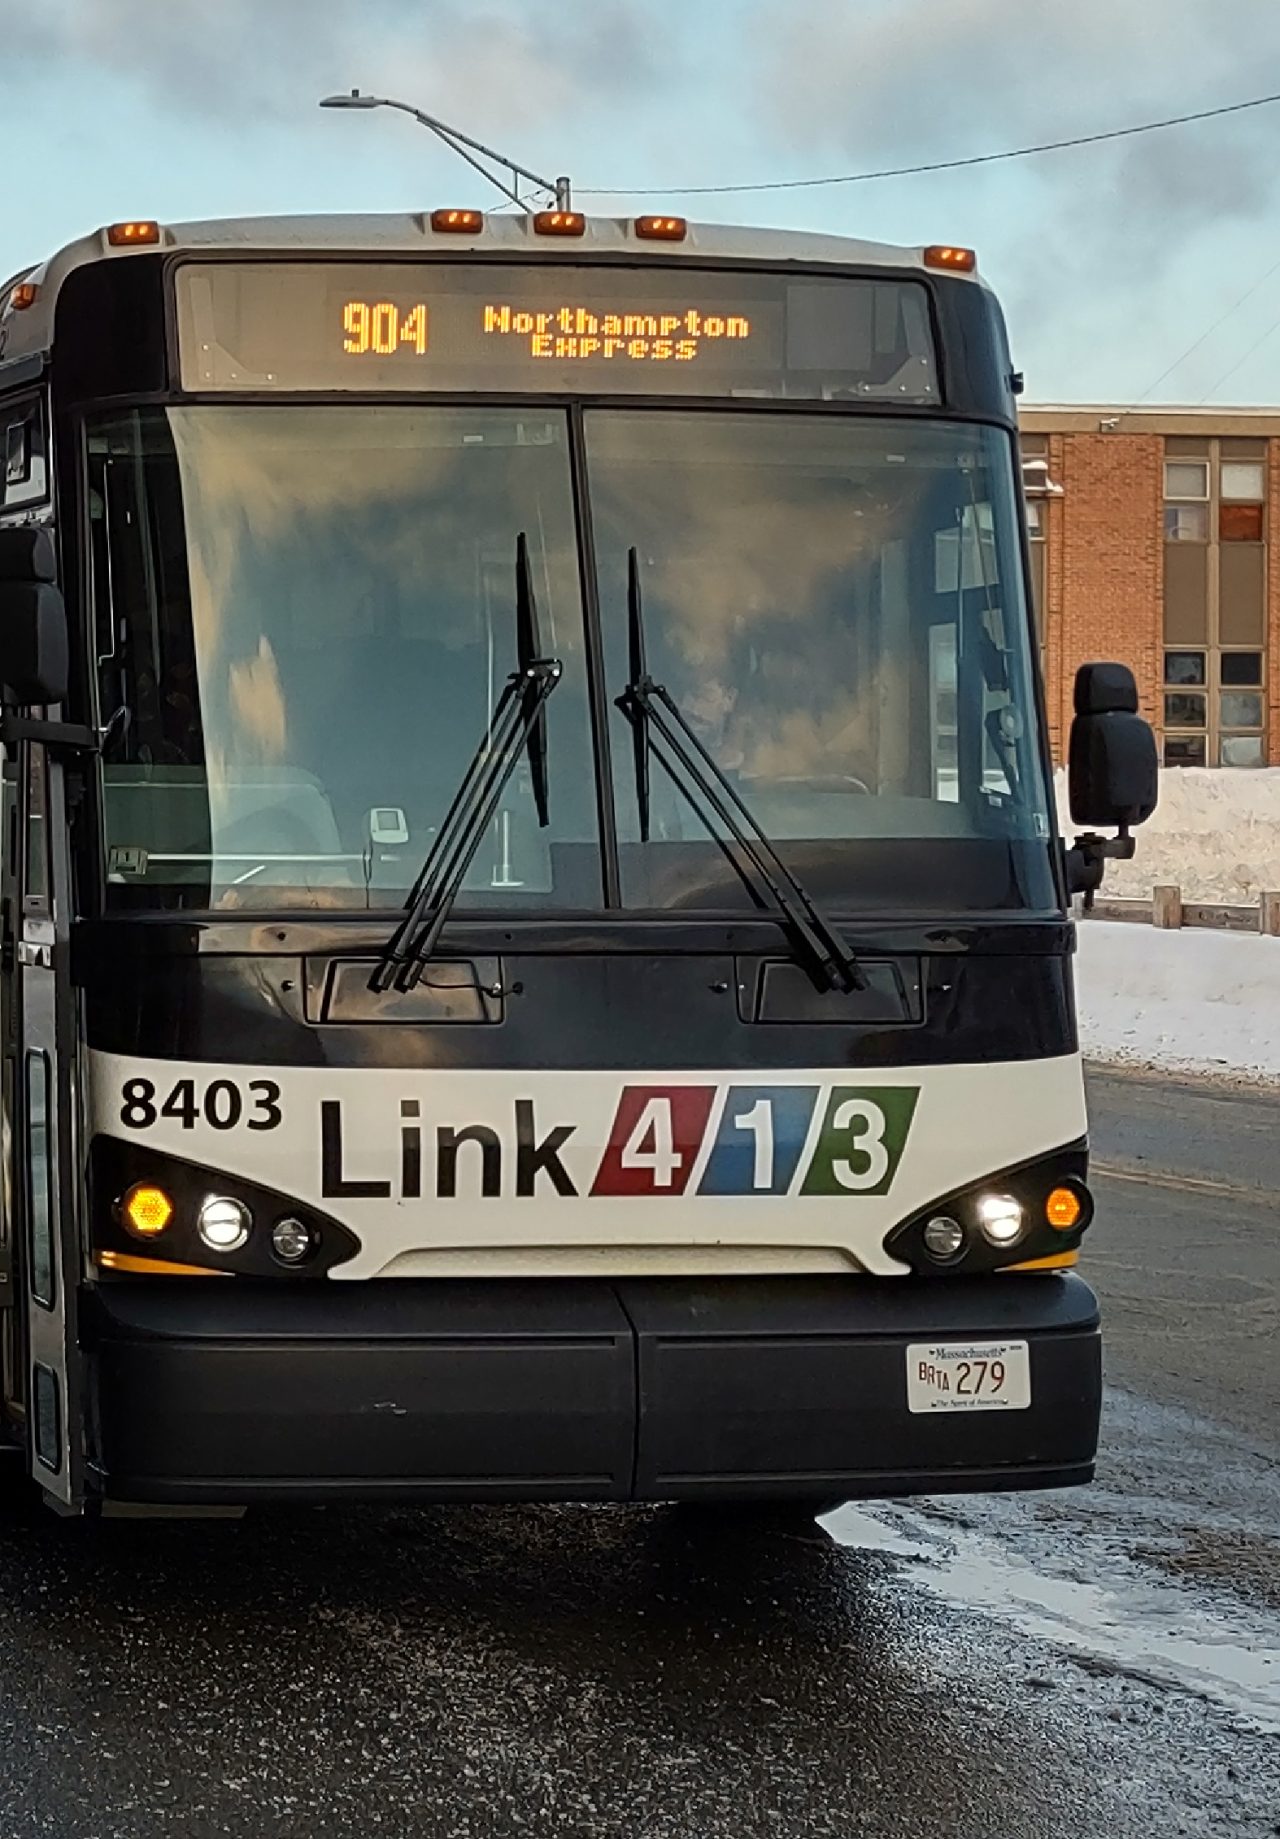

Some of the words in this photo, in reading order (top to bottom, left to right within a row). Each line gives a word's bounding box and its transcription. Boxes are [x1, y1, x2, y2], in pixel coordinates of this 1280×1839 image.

[344, 303, 426, 355] 904
[484, 306, 749, 338] Northampton
[531, 333, 697, 360] Express
[120, 1078, 282, 1130] 8403
[956, 1360, 1005, 1394] 279
